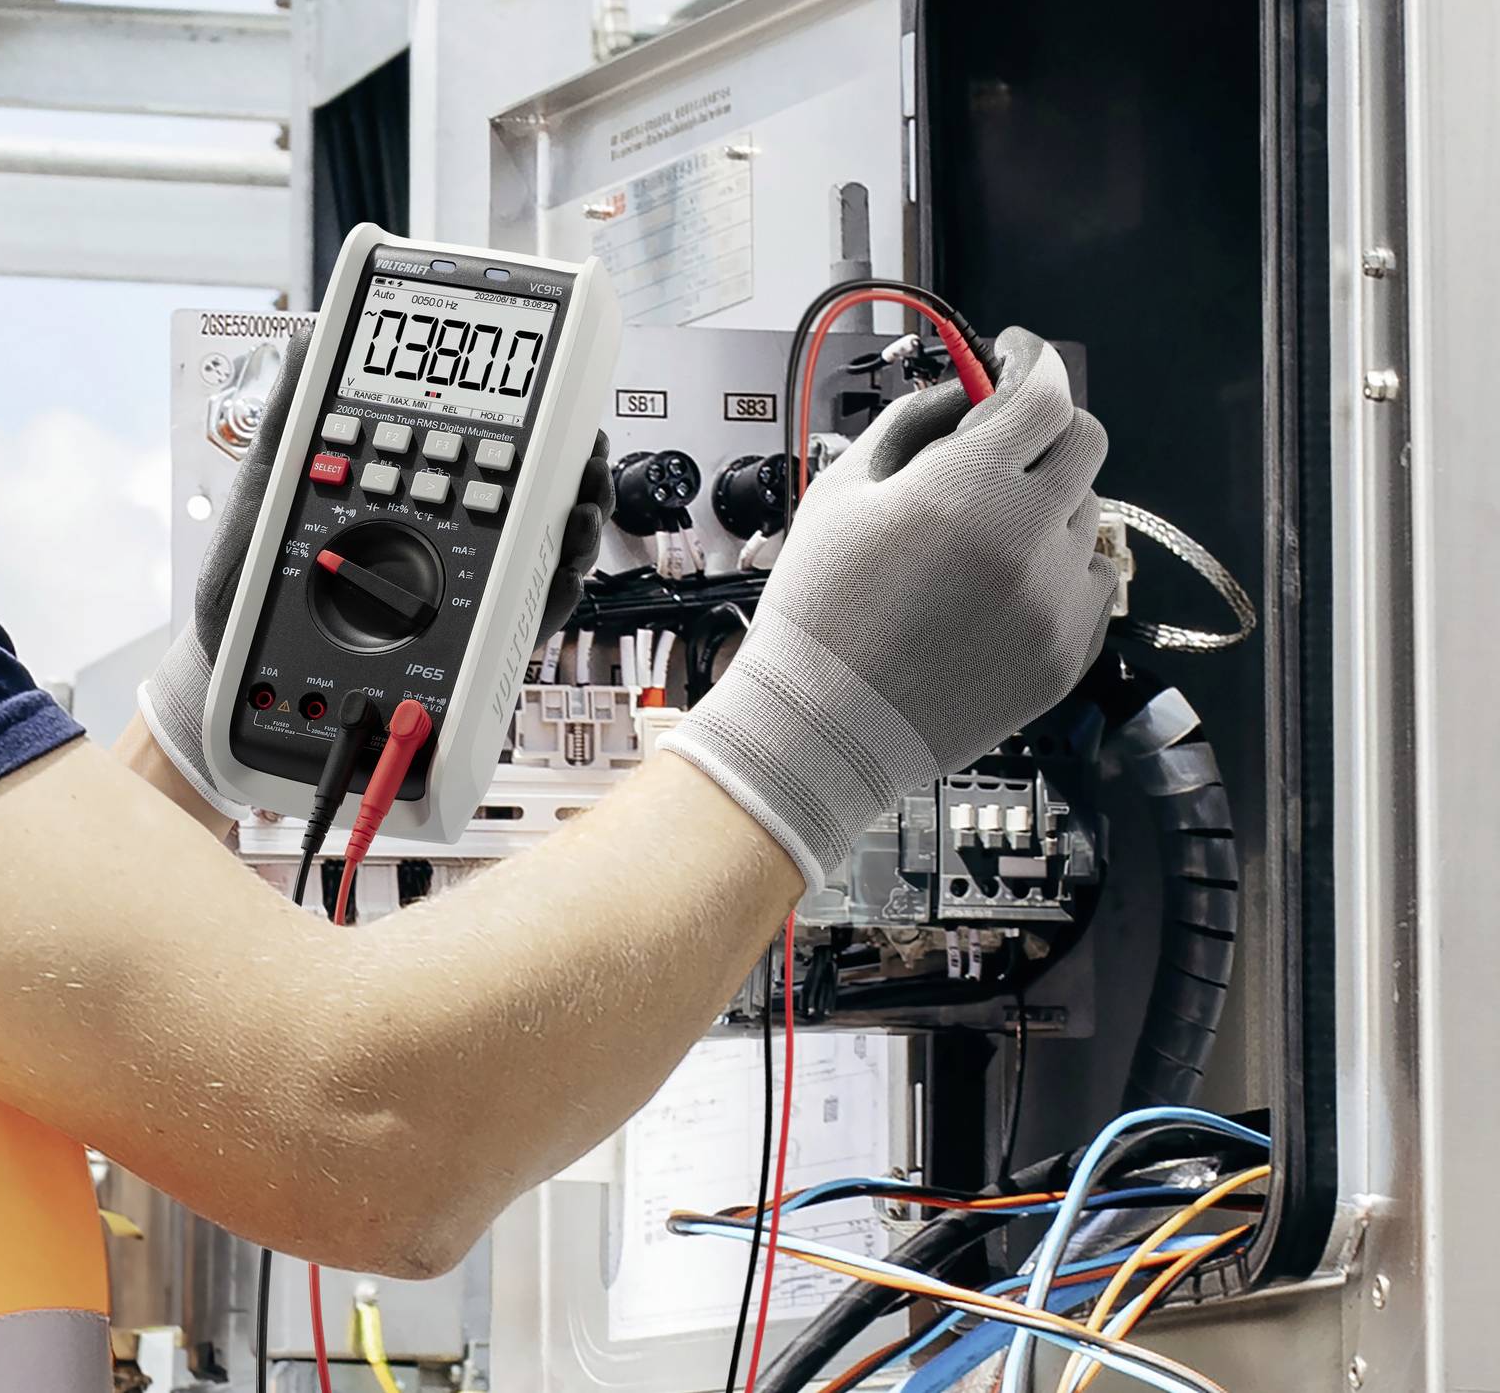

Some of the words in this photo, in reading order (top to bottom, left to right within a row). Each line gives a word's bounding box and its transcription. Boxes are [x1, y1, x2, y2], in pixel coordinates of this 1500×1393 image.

[375, 259, 431, 275] VOLTCRAFT
[373, 289, 395, 301] Auto
[529, 282, 563, 296] VC915
[446, 300, 458, 311] Hz
[474, 292, 517, 305] 2022/06/15
[522, 299, 553, 311] 13:06:22
[363, 309, 543, 398] 0380.0
[347, 377, 355, 386] V
[353, 390, 383, 402] RANGE
[412, 399, 428, 410] MIN
[442, 405, 458, 415] REL
[628, 395, 656, 413] SB1
[736, 398, 767, 417] SB3
[480, 411, 504, 422] HOLD
[333, 423, 346, 433] F1
[336, 405, 364, 417] 20000
[364, 409, 395, 422] Counts
[396, 414, 416, 426] True
[416, 418, 439, 430] RMS
[439, 421, 467, 435] Digital
[467, 426, 514, 442] Multimeter
[385, 431, 398, 442] F2
[435, 439, 449, 450] F3
[487, 448, 501, 459] F4
[314, 462, 342, 474] SELECT
[387, 502, 409, 514] Hz%
[282, 566, 301, 577] OFF
[451, 597, 472, 608] OFF
[493, 523, 554, 724] VOLTCRAFT
[260, 666, 278, 678] 10A
[405, 663, 445, 681] IP65
[273, 720, 290, 728] FUSED
